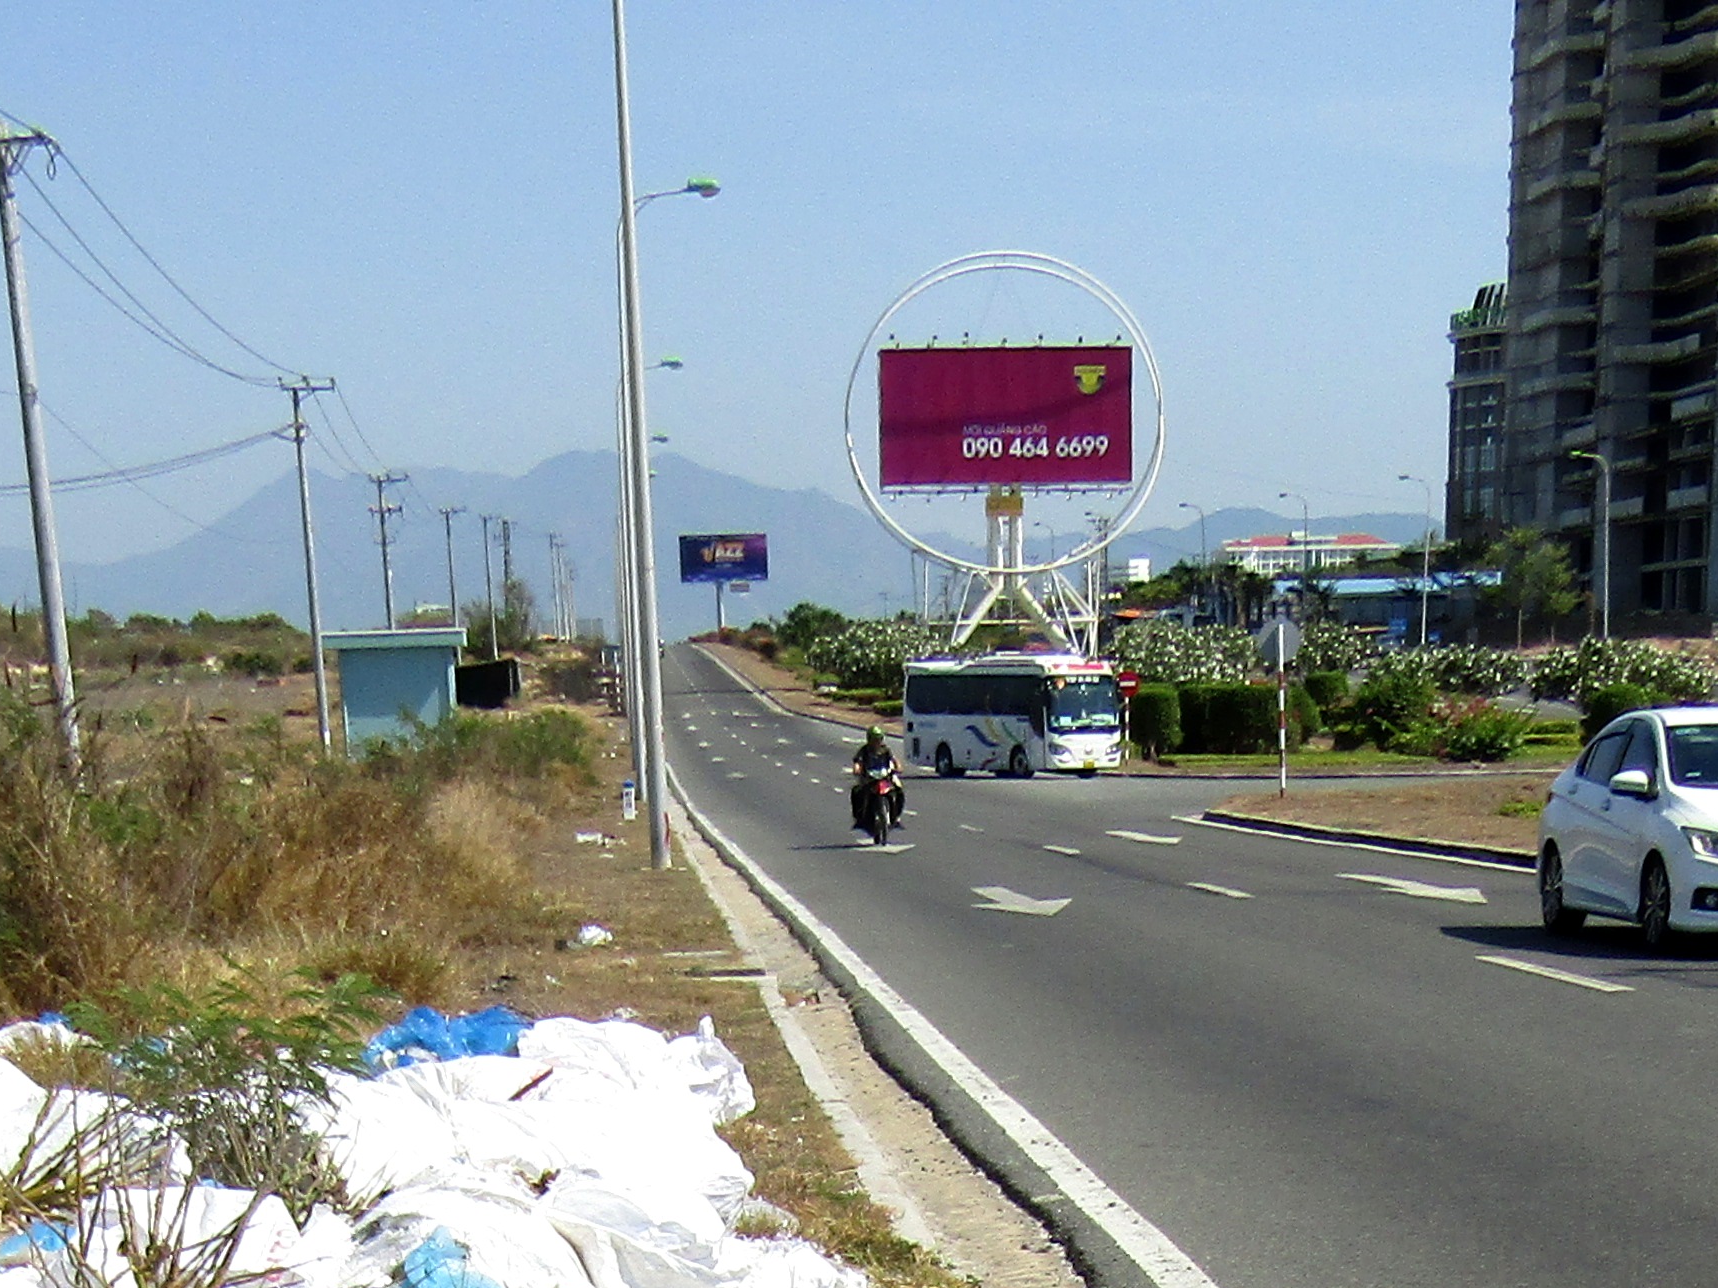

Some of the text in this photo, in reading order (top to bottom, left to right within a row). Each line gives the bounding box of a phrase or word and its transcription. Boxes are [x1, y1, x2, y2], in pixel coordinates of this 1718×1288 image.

[962, 436, 1109, 458] 090 464 6699
